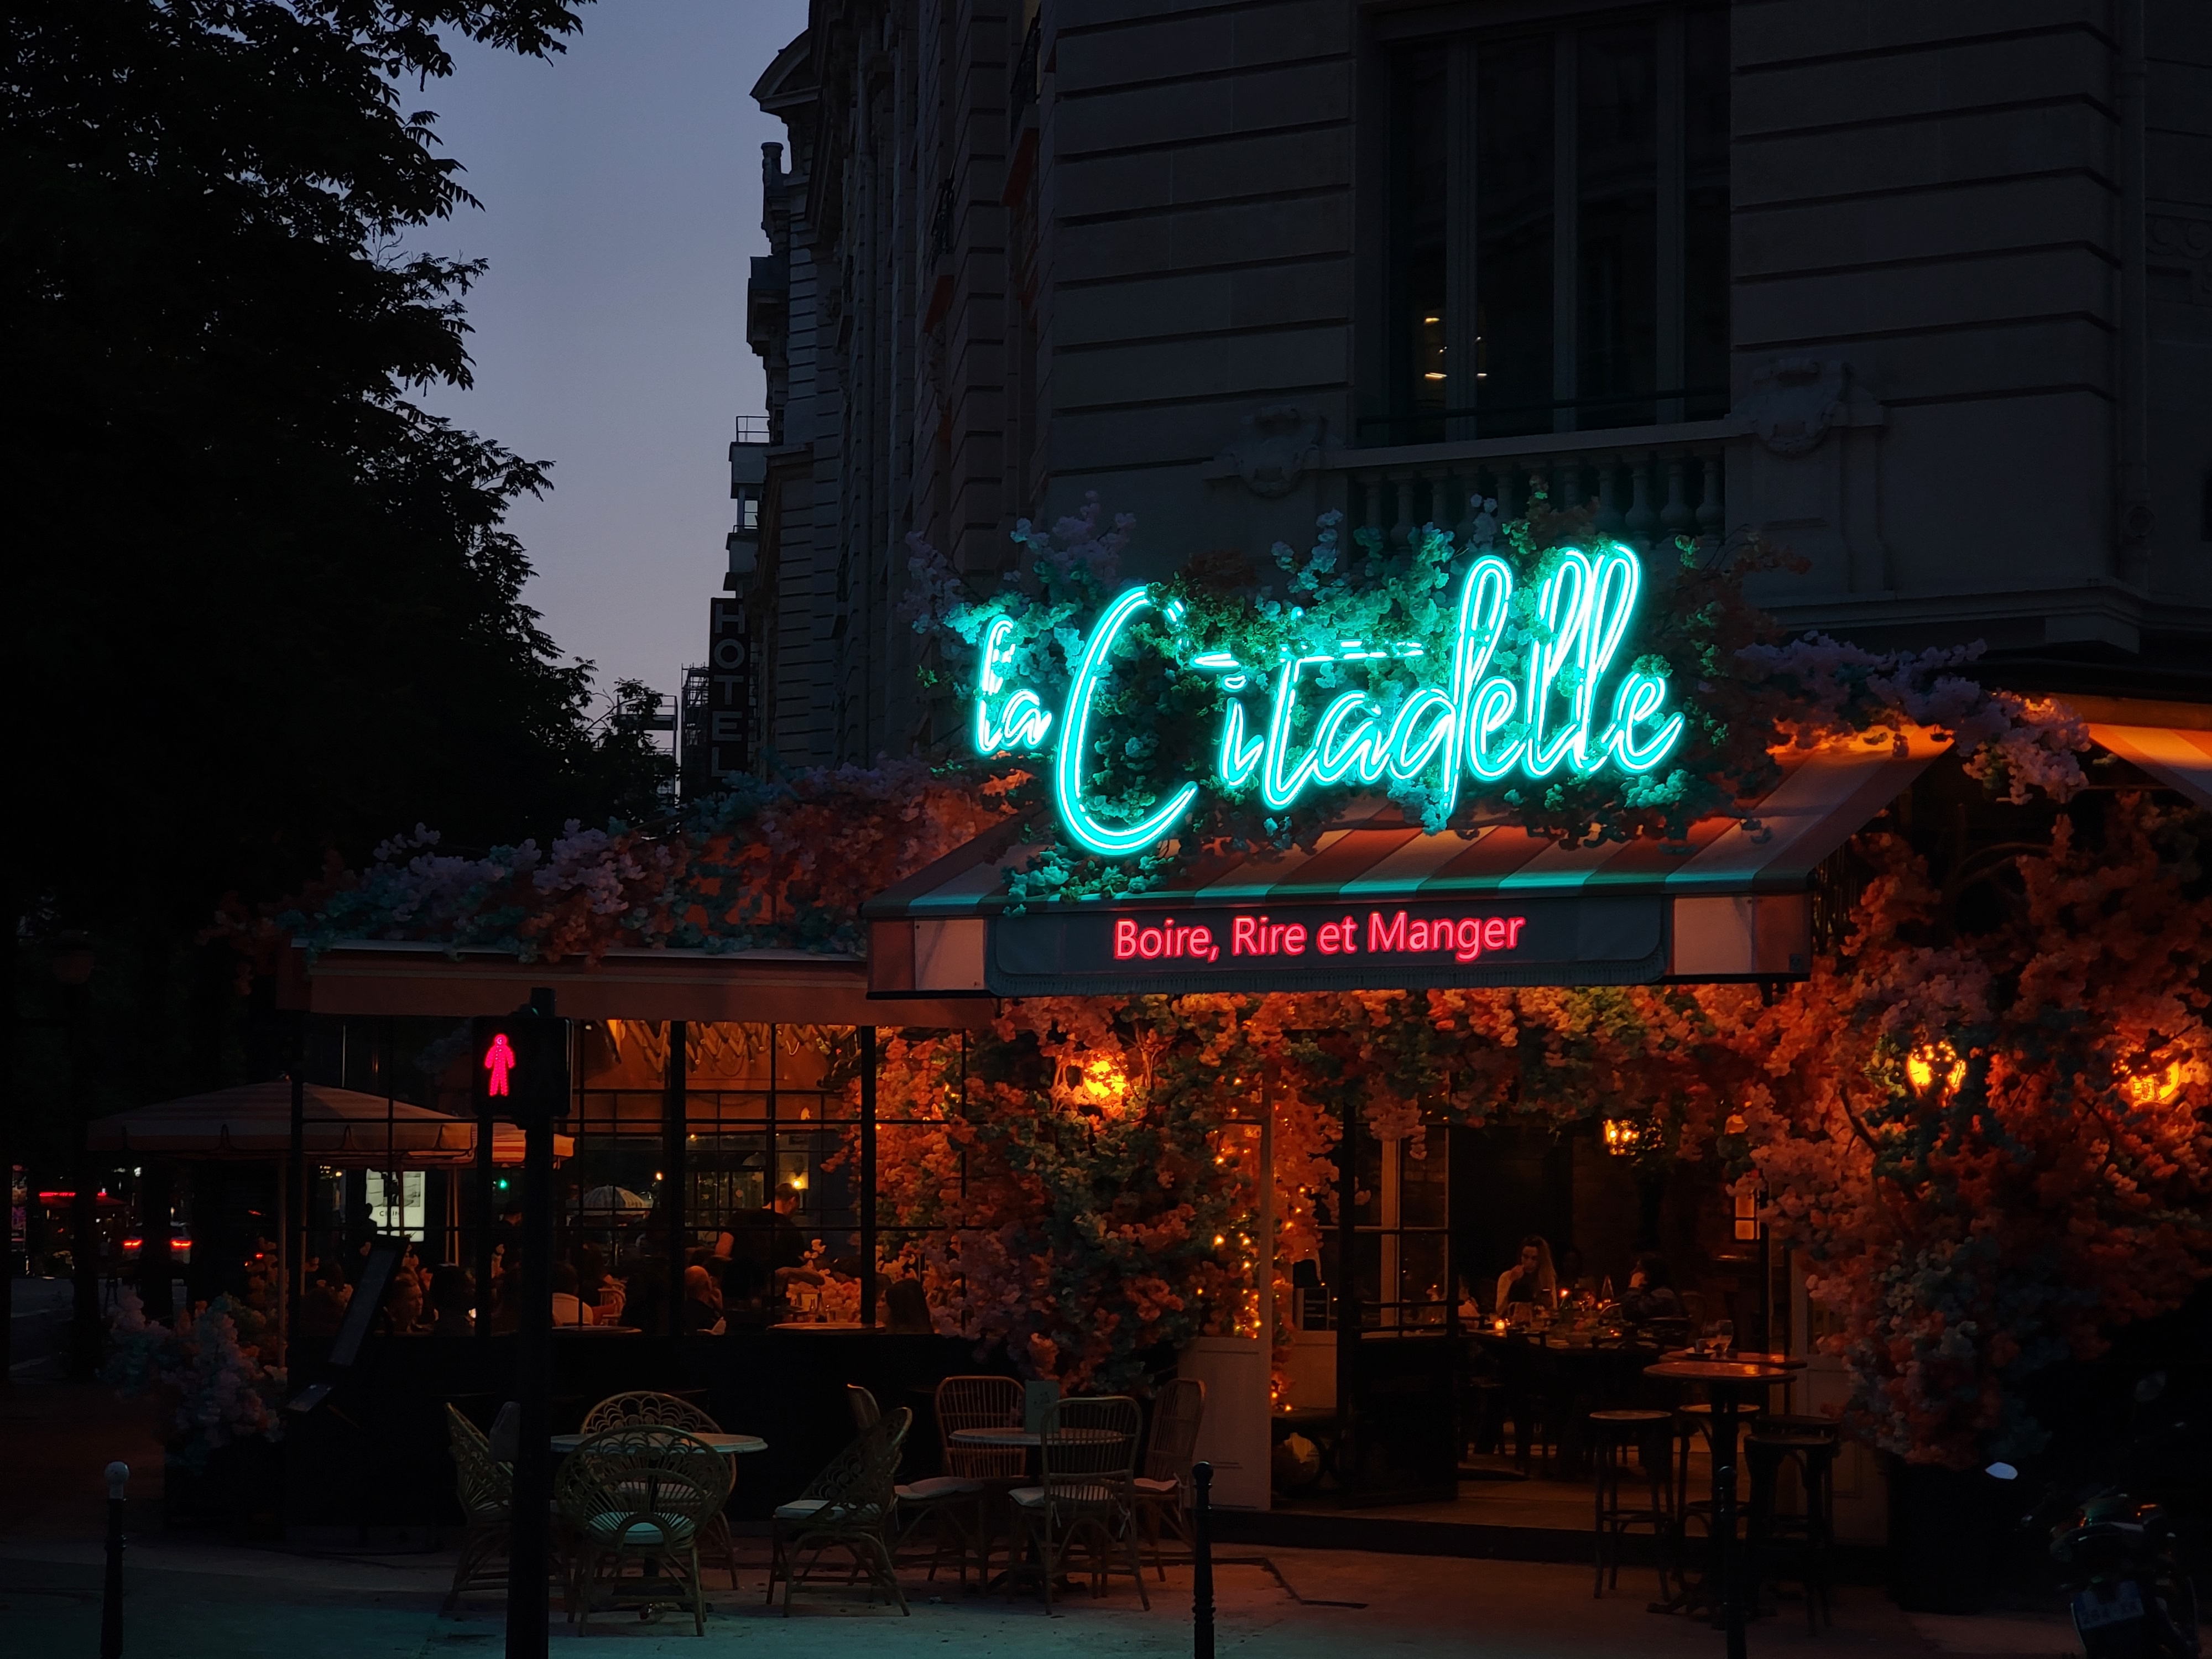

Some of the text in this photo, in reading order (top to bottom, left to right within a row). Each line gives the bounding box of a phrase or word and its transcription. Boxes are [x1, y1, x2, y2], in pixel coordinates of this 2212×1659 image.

[713, 603, 747, 778] HOTEL
[1055, 545, 1686, 855] Citadelle
[1113, 911, 1526, 963] Boire, Rire et Manger
